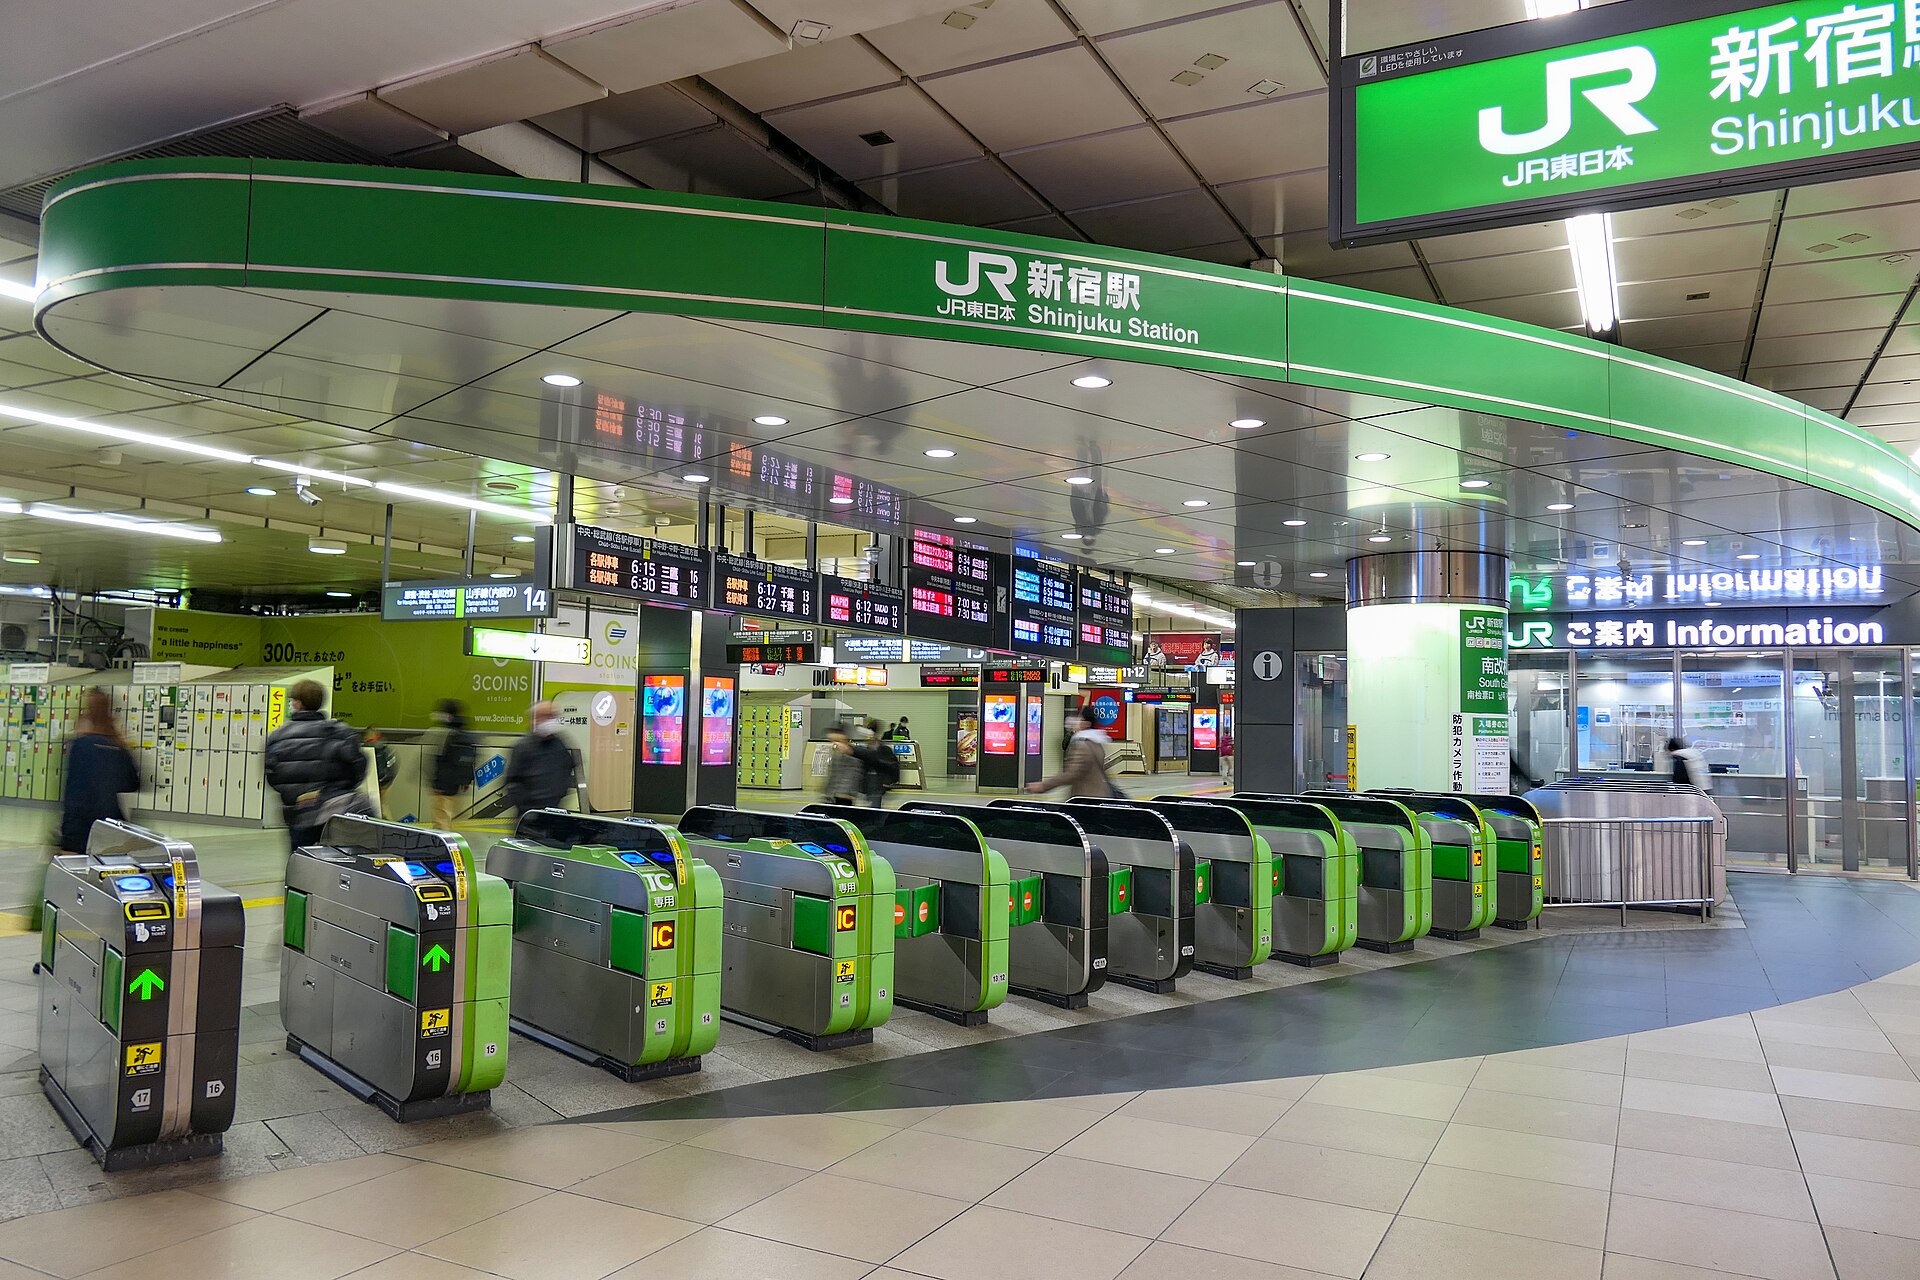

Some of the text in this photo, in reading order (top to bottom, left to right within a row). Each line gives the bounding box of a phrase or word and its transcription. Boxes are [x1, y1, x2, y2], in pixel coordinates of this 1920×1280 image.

[1380, 46, 1438, 64] 環境にやさしい
[1709, 0, 1920, 103] 新宿
[1380, 49, 1463, 73] LEDを使用しています
[1478, 46, 1658, 155] JR
[1502, 145, 1633, 188] JR東日本
[935, 250, 1017, 302] JR
[1027, 260, 1142, 311] 新宿駅
[936, 298, 1016, 322] JR東日本
[1028, 304, 1199, 345] Shinjuku Station
[590, 552, 619, 570] 各駅停車
[631, 560, 656, 577] 6:15
[690, 570, 698, 584] 16
[958, 554, 970, 565] 6:34
[958, 564, 970, 576] 6:51
[590, 569, 618, 586] 各駅停車
[630, 576, 656, 592] 6:30
[689, 586, 698, 599] 16
[726, 577, 810, 602] 各駅停車 6:17 千葉 13
[466, 586, 517, 599] 山手線(内回り)
[523, 586, 546, 612] 14
[726, 592, 810, 616] 各駅停車 6:27 千葉 13
[830, 594, 898, 616] RAPID 6:12 TAKAO 12
[958, 596, 970, 609] 7:00
[983, 602, 988, 612] 9
[856, 612, 872, 624] 6:17
[874, 616, 888, 626] TAKAO
[892, 618, 898, 628] 12
[958, 608, 970, 620] 7:30
[1466, 616, 1485, 630] JR
[802, 630, 812, 642] 13
[1508, 617, 1884, 648] JR ご案内 Information
[170, 638, 190, 648] little
[192, 640, 242, 652] happiness"
[576, 643, 588, 660] 13
[1160, 642, 1202, 654] 送料無料
[1037, 660, 1046, 668] 12
[472, 674, 528, 692] 3COINS
[1478, 677, 1500, 688] South
[474, 714, 524, 725] www.3coins.jp
[1452, 714, 1462, 792] 防犯カメラ作動
[828, 862, 854, 879] IC
[642, 874, 674, 892] IC
[839, 882, 856, 894] 専用
[654, 896, 674, 908] 専用
[151, 924, 166, 932] きっぷ
[838, 910, 855, 930] IC
[652, 926, 672, 948] IC
[879, 990, 886, 998] 13
[658, 1014, 710, 1029] 15 14
[430, 1045, 495, 1062] 16 15
[137, 1084, 220, 1102] 17 16
